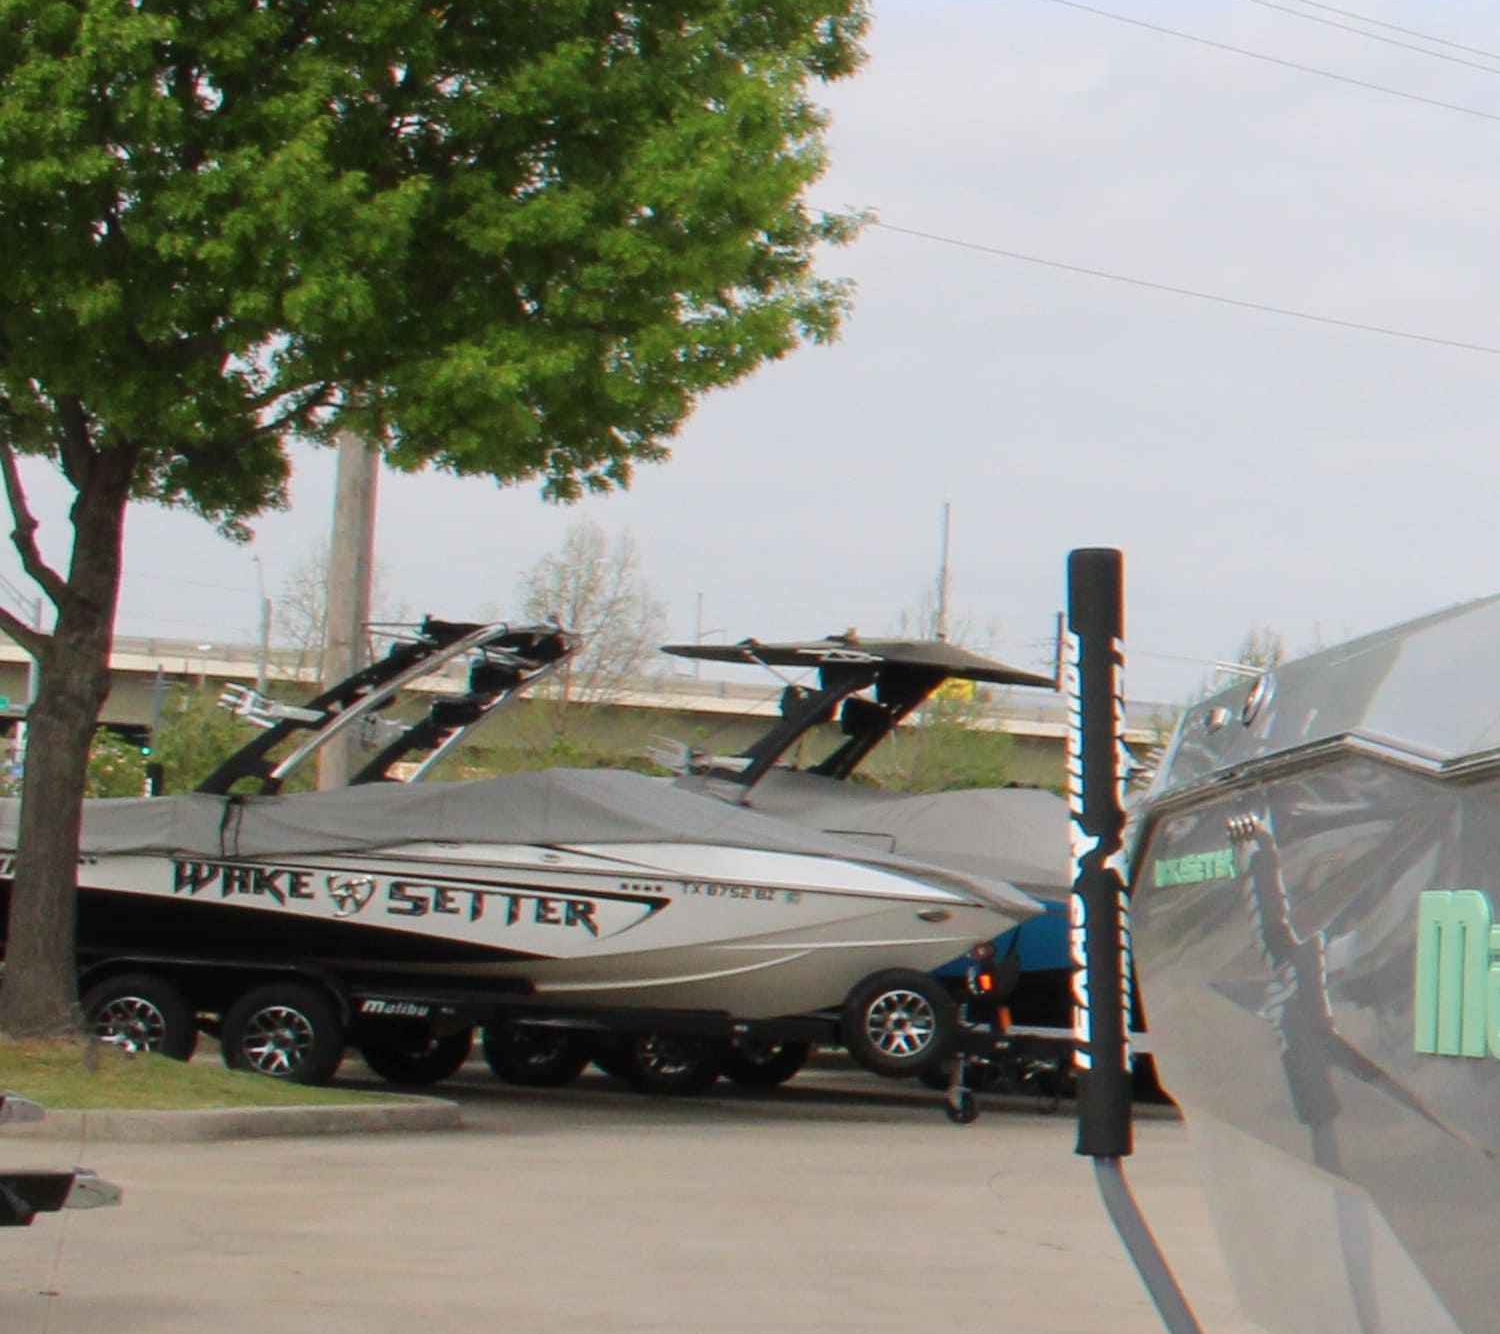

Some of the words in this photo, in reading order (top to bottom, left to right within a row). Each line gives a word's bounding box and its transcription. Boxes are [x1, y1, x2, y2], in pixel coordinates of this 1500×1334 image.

[170, 860, 315, 907] WAKE
[387, 880, 600, 938] SETTER
[361, 999, 430, 1016] Malibu
